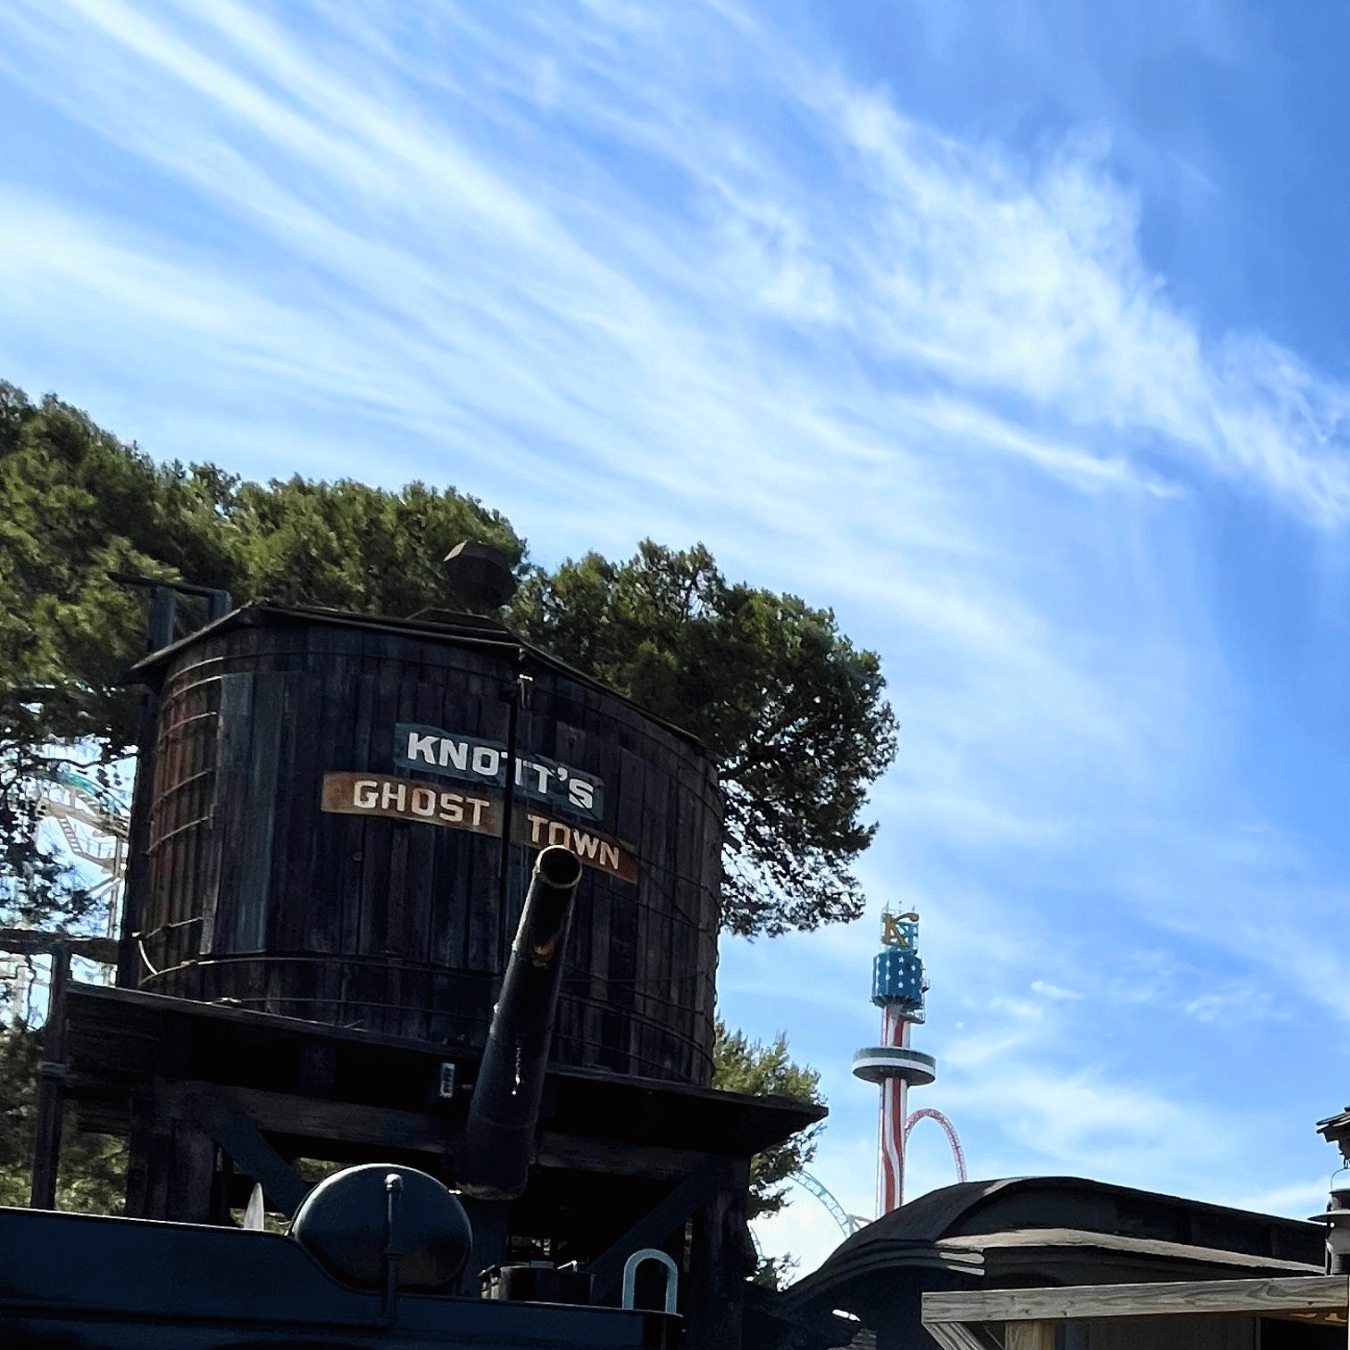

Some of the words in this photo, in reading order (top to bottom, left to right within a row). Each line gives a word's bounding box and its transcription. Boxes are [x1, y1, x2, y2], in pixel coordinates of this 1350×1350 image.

[407, 731, 595, 810] KNOTT'S
[353, 780, 490, 827] GHOST
[527, 813, 619, 871] TOWN
